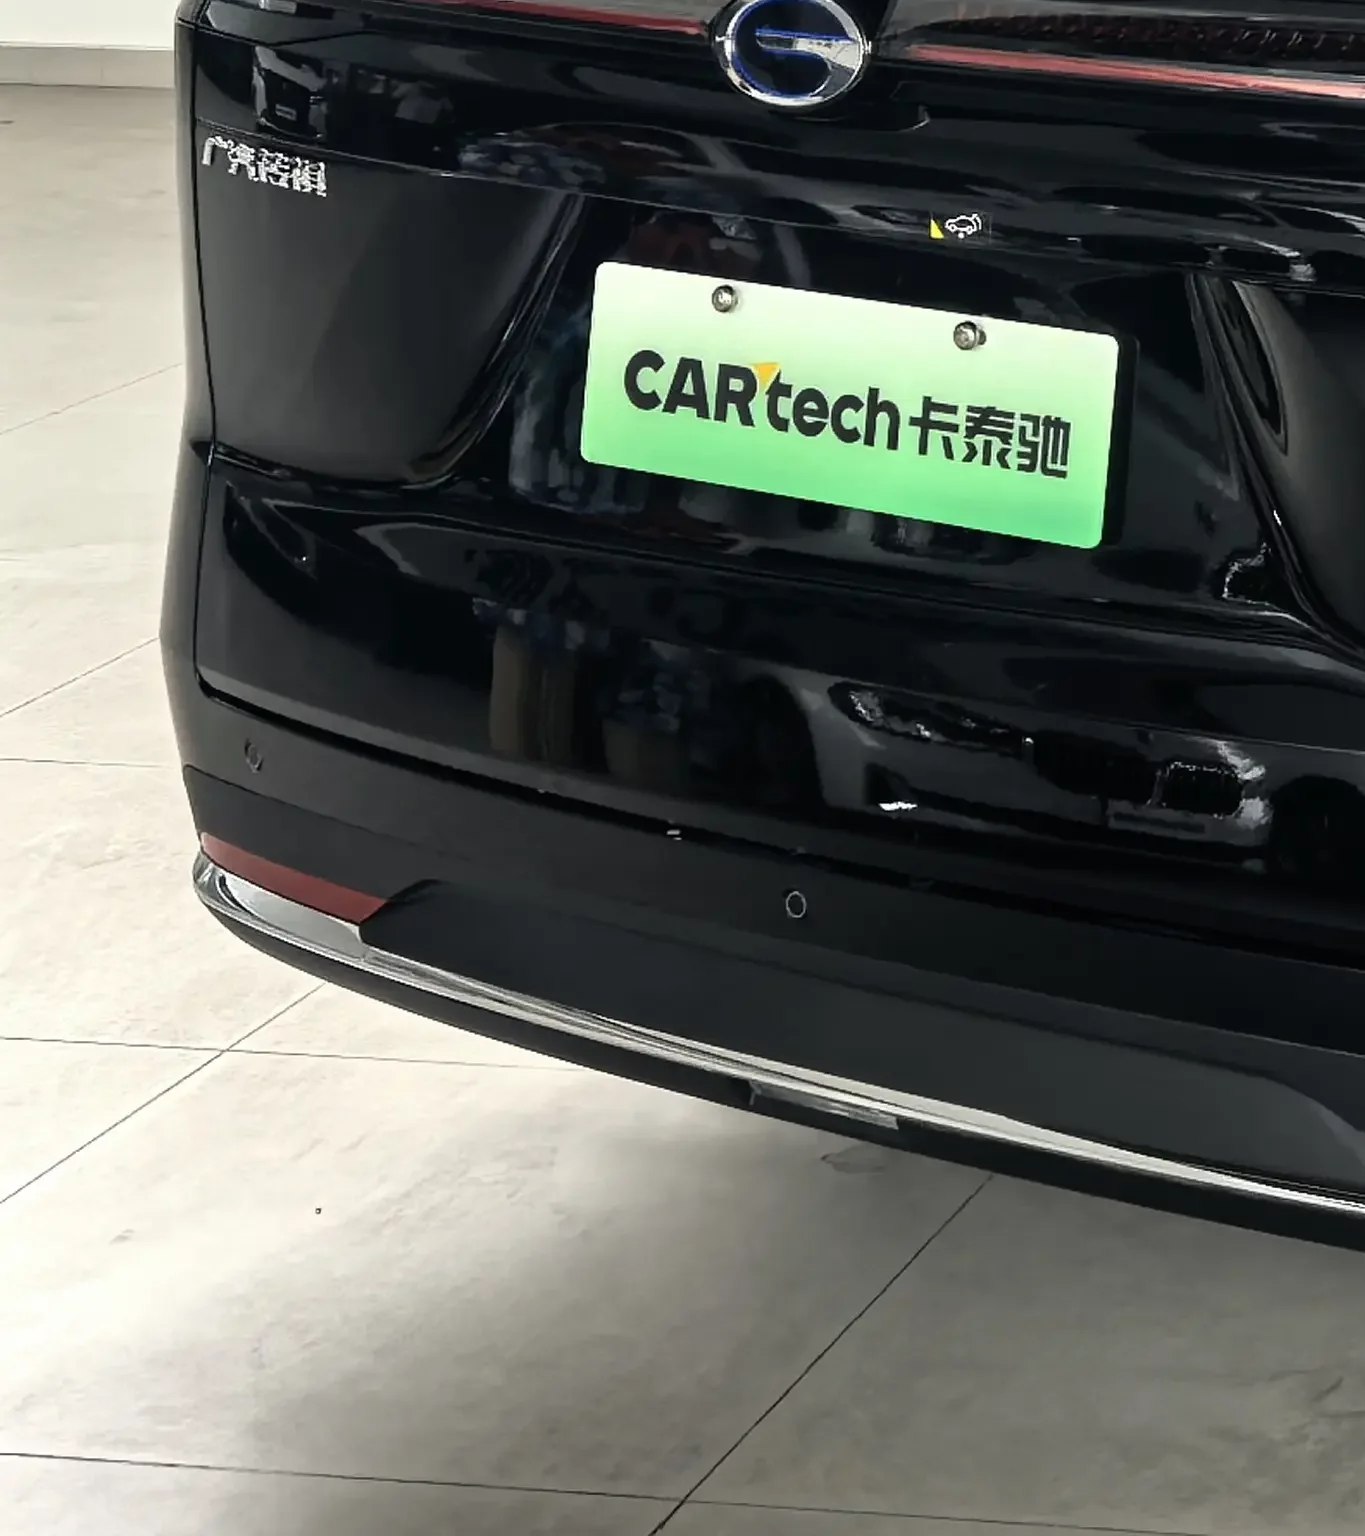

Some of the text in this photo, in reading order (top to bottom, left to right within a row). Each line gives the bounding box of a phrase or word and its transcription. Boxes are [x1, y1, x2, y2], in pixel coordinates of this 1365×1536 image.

[623, 350, 1072, 479] CARtech 卡泰驰
